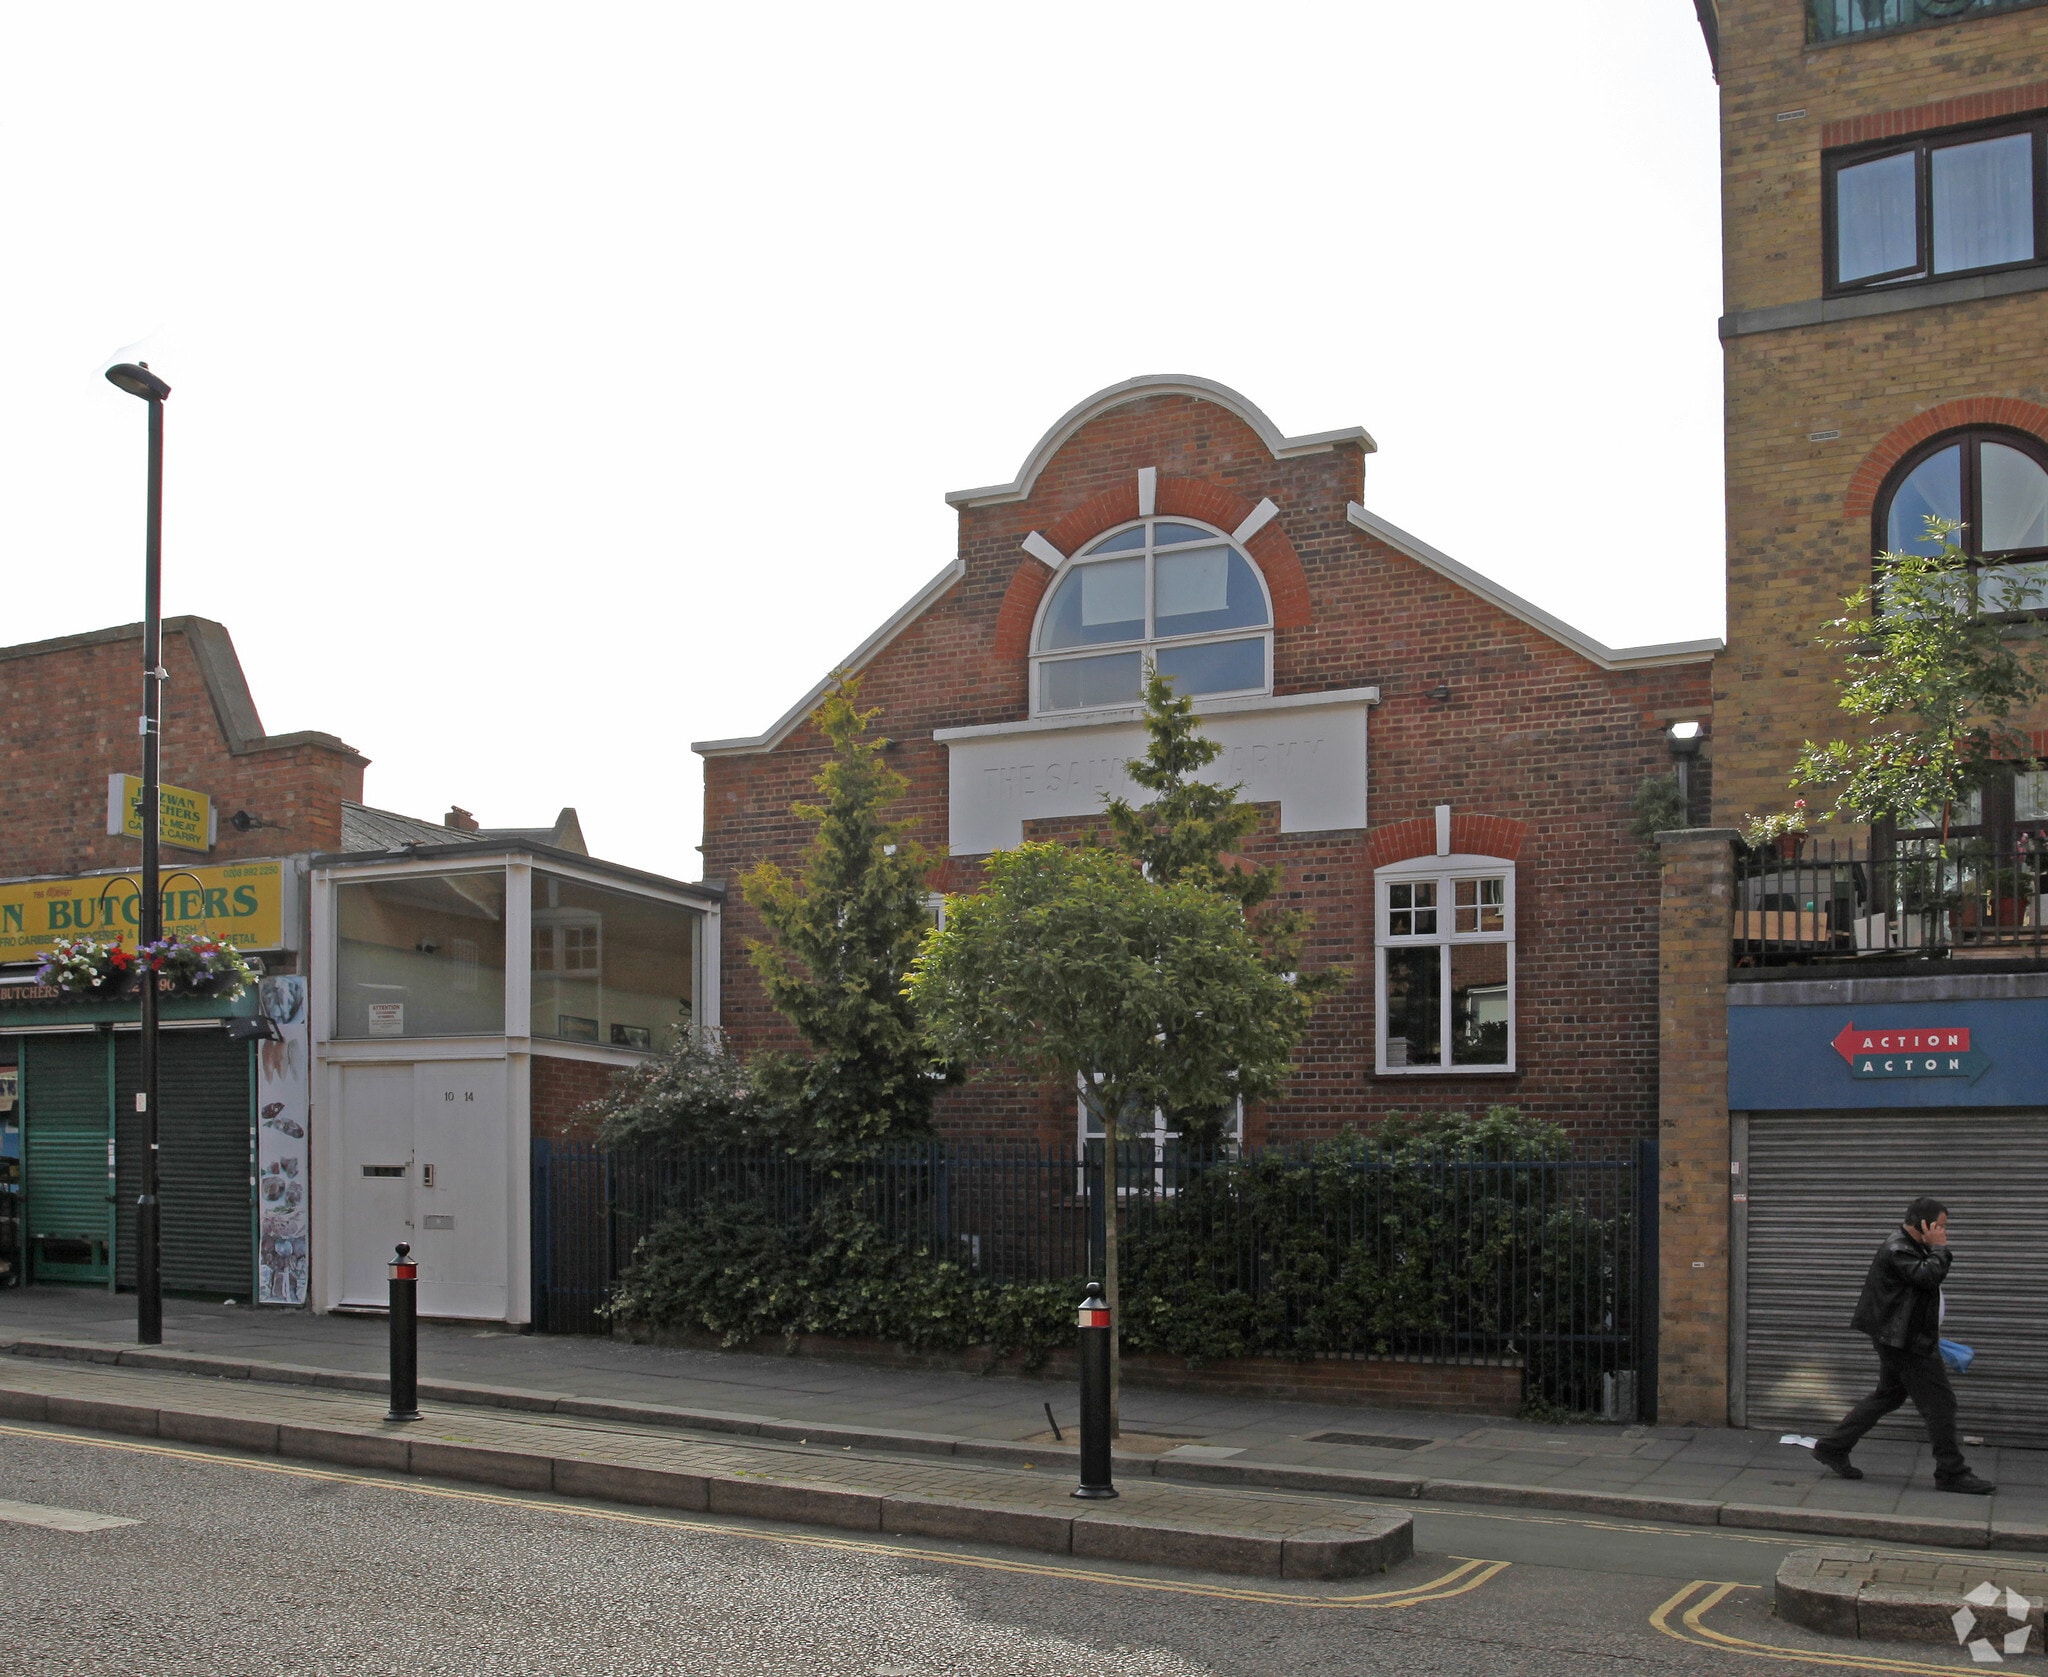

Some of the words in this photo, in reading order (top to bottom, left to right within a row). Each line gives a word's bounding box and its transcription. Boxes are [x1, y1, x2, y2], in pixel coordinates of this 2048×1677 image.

[983, 764, 1035, 797] THE
[131, 797, 200, 821] BCHERS
[169, 819, 196, 832] MEAT
[167, 829, 202, 843] CARRY
[48, 885, 258, 930] BUTCHERS
[0, 985, 60, 1000] BUTCHERS
[1862, 1035, 1958, 1048] ACTION
[1862, 1058, 1960, 1072] ACTON
[444, 1091, 455, 1102] 10
[465, 1091, 474, 1102] 14
